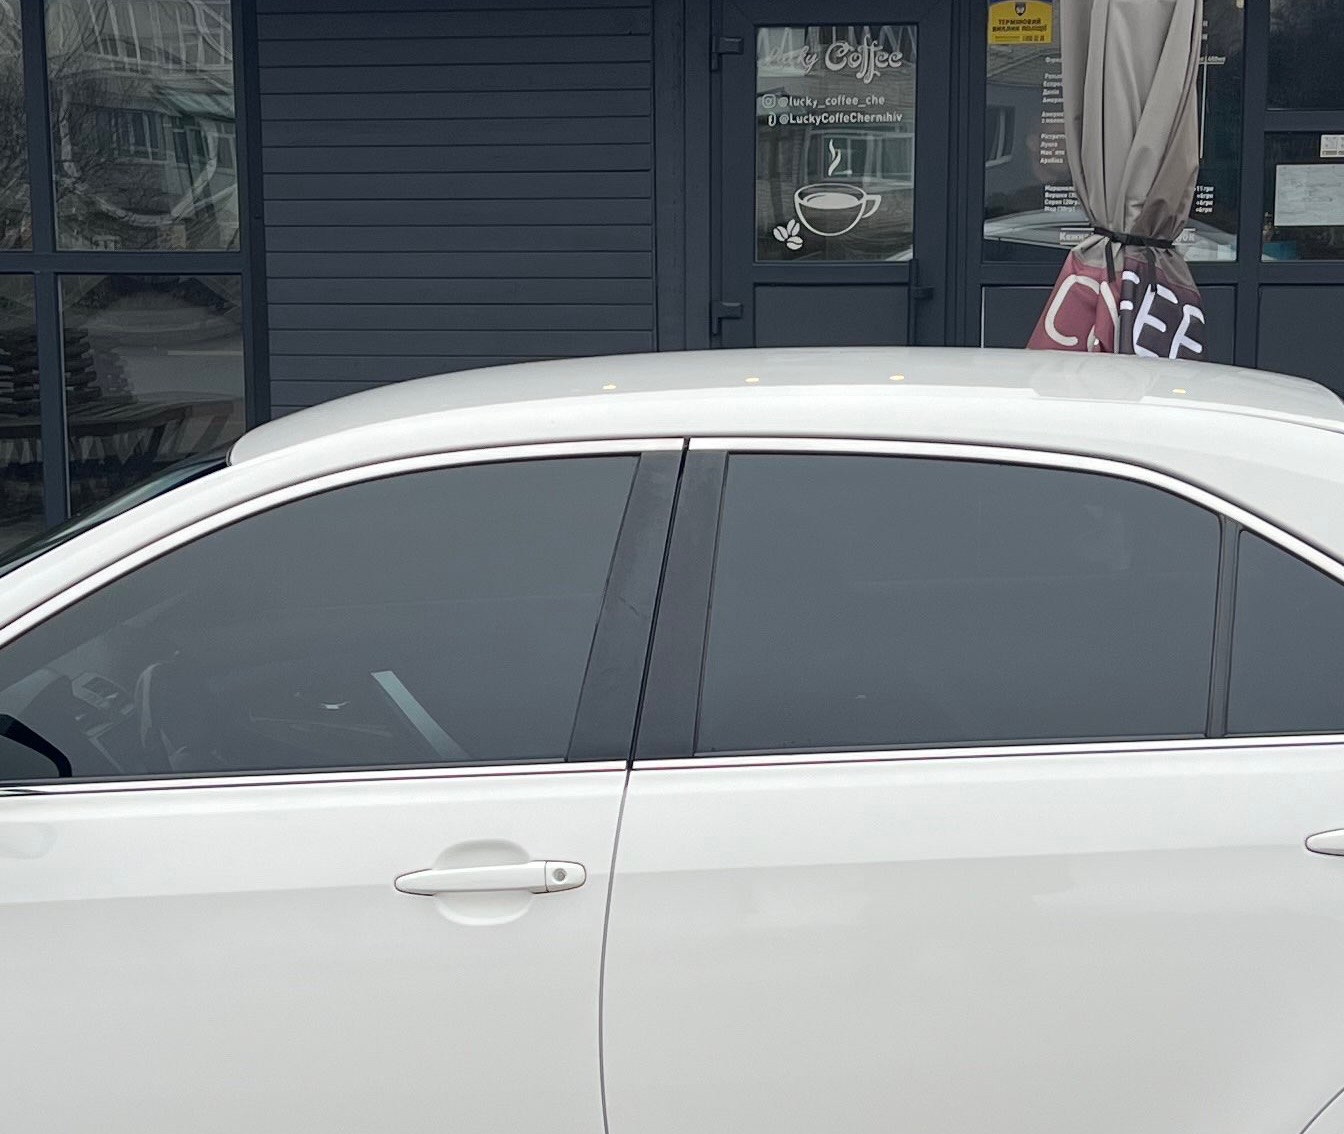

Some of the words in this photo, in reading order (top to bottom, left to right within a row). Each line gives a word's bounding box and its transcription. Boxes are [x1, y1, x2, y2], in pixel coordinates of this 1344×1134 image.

[824, 33, 903, 84] Coffee
[777, 95, 886, 109] @lucky_coffee_che
[779, 110, 903, 126] @LuckyCoffeChernihiv
